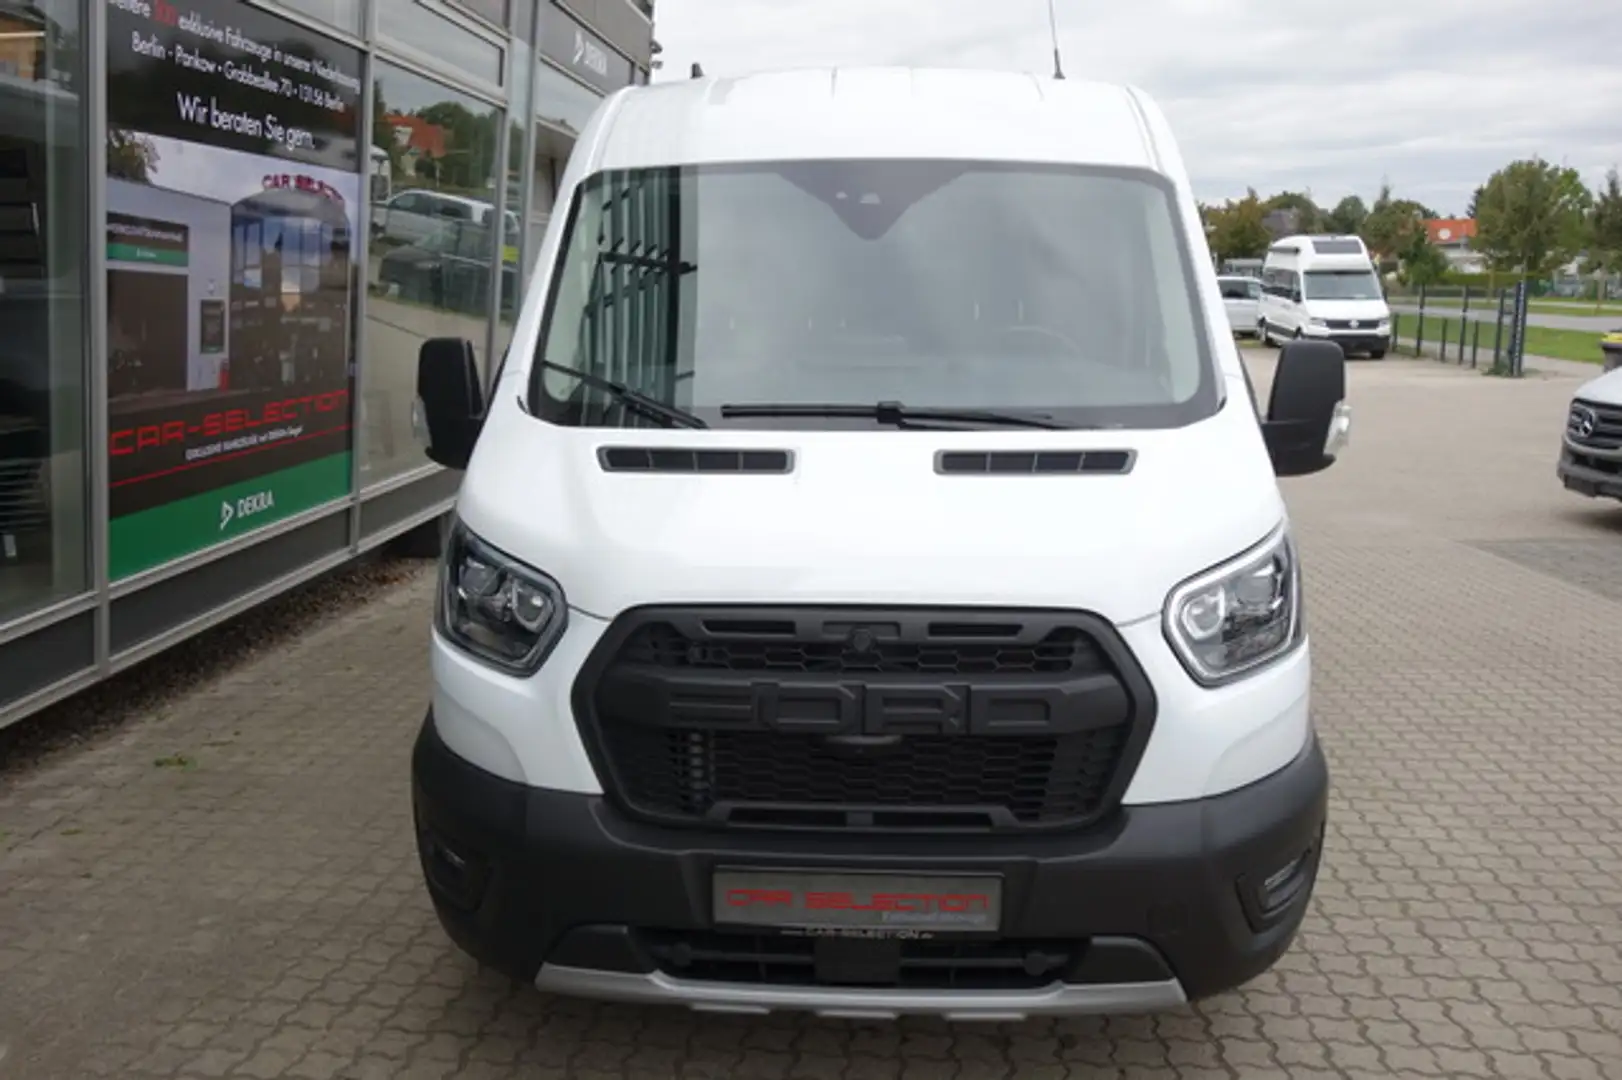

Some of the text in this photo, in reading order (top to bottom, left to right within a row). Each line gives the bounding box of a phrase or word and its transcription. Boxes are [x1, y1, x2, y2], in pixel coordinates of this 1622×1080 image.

[132, 30, 165, 60] Berlin
[175, 43, 216, 73] Pankow
[176, 91, 208, 124] Wir
[210, 96, 262, 137] beraten
[264, 113, 285, 142] Sie
[237, 489, 275, 518] DEKRA
[726, 889, 793, 907] CAR
